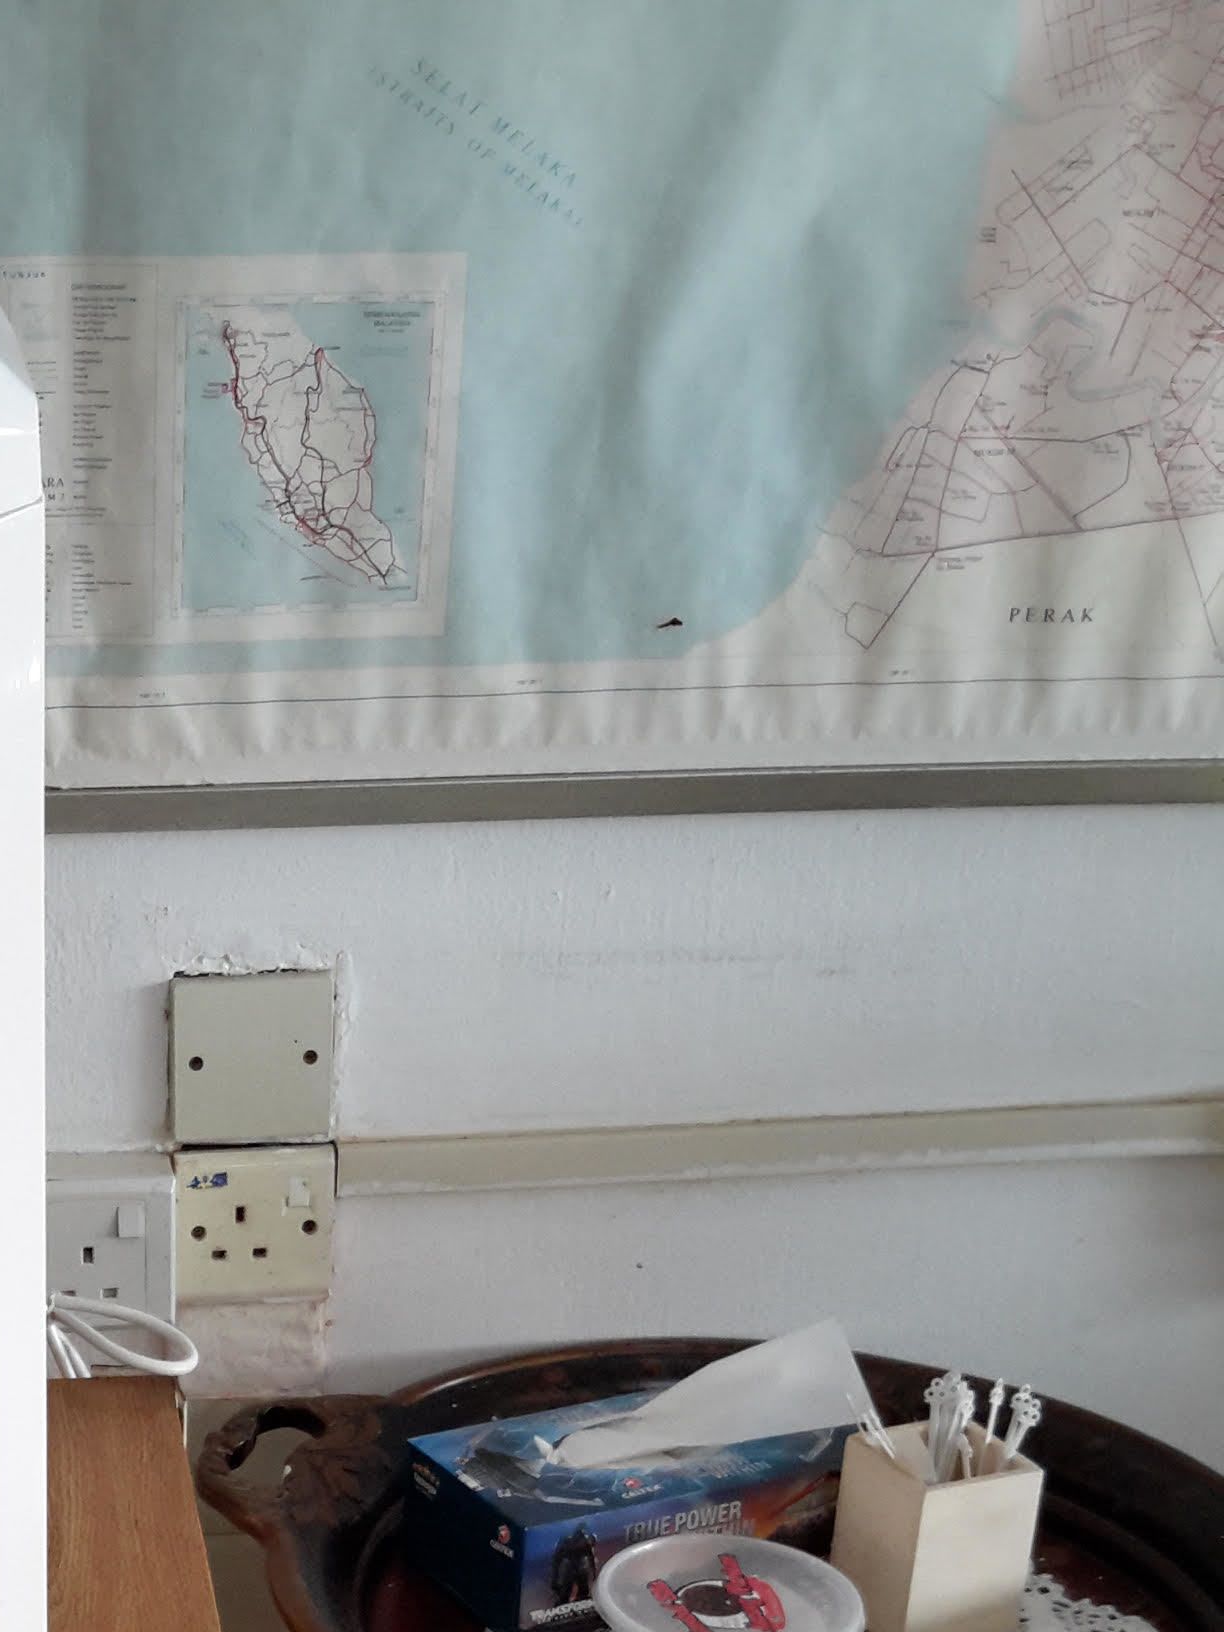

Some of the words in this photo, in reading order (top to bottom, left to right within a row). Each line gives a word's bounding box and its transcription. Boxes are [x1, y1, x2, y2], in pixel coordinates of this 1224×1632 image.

[494, 117, 577, 188] MELAKA
[1009, 606, 1096, 624] PERAK
[624, 1515, 672, 1544] TRUE
[674, 1500, 743, 1533] POWER
